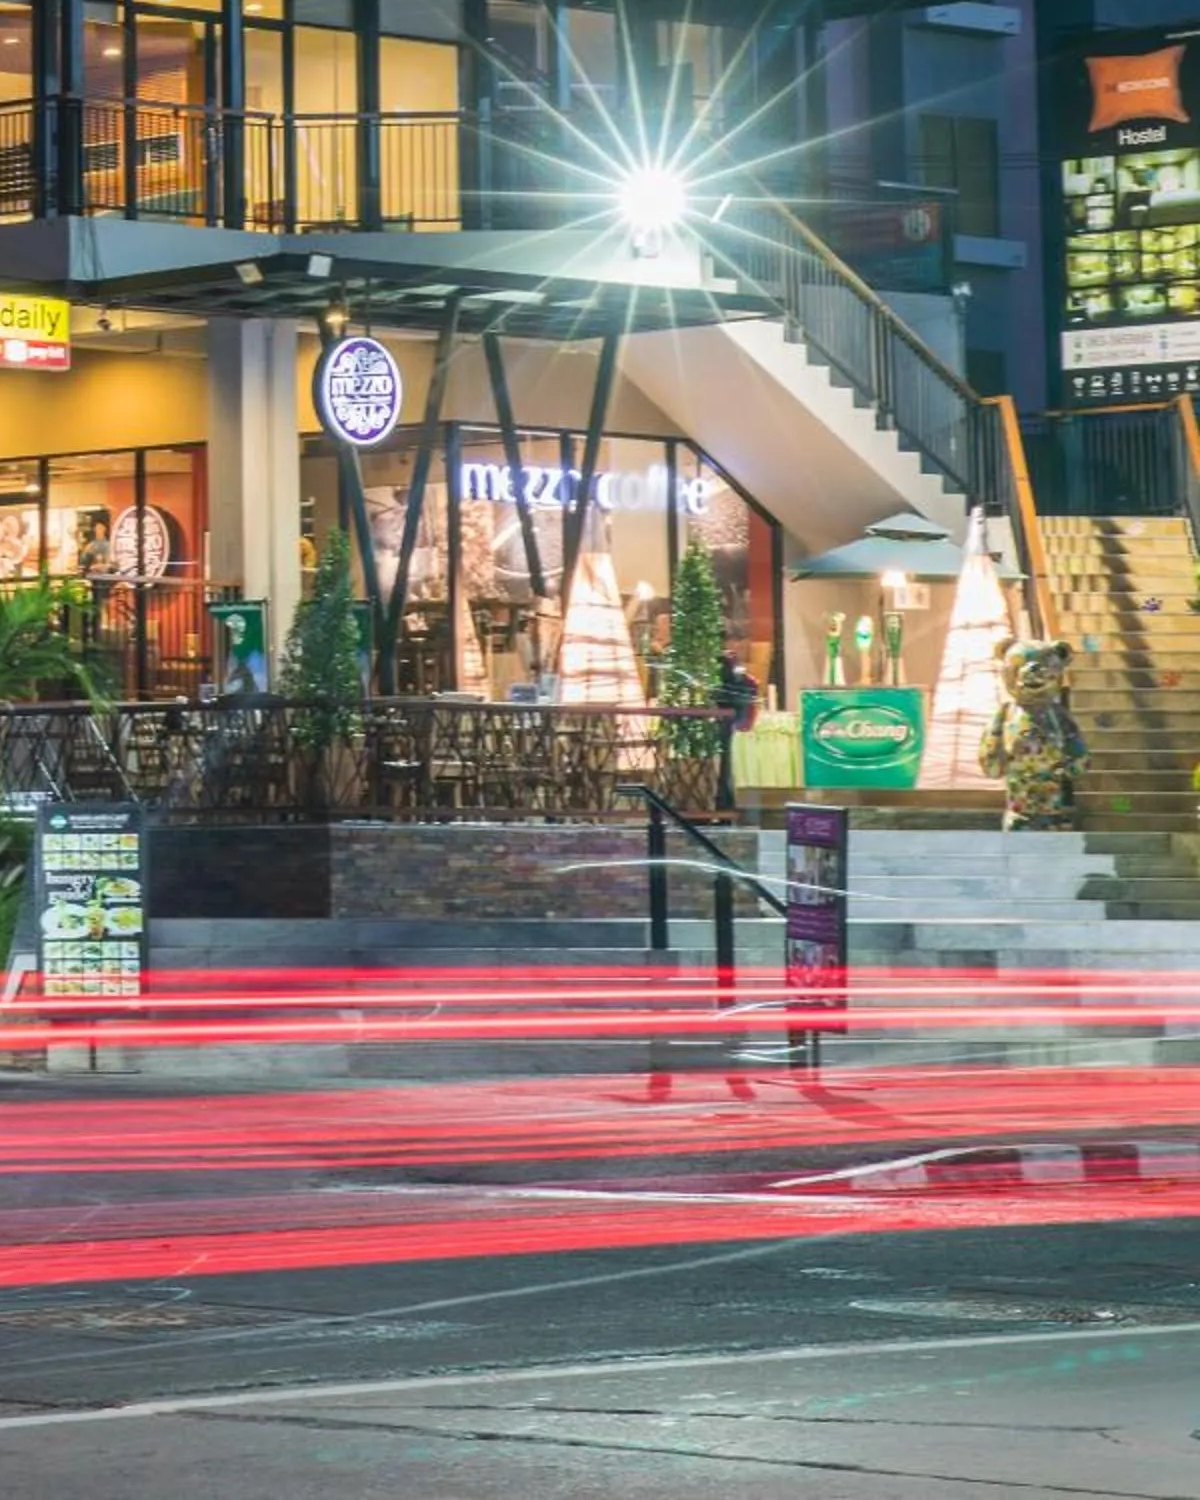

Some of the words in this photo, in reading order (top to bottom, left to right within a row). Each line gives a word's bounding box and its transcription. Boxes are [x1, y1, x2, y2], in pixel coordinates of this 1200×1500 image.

[1118, 125, 1167, 146] Hostel
[0, 301, 61, 336] daily
[330, 374, 394, 397] mezzo
[597, 464, 709, 514] coffe
